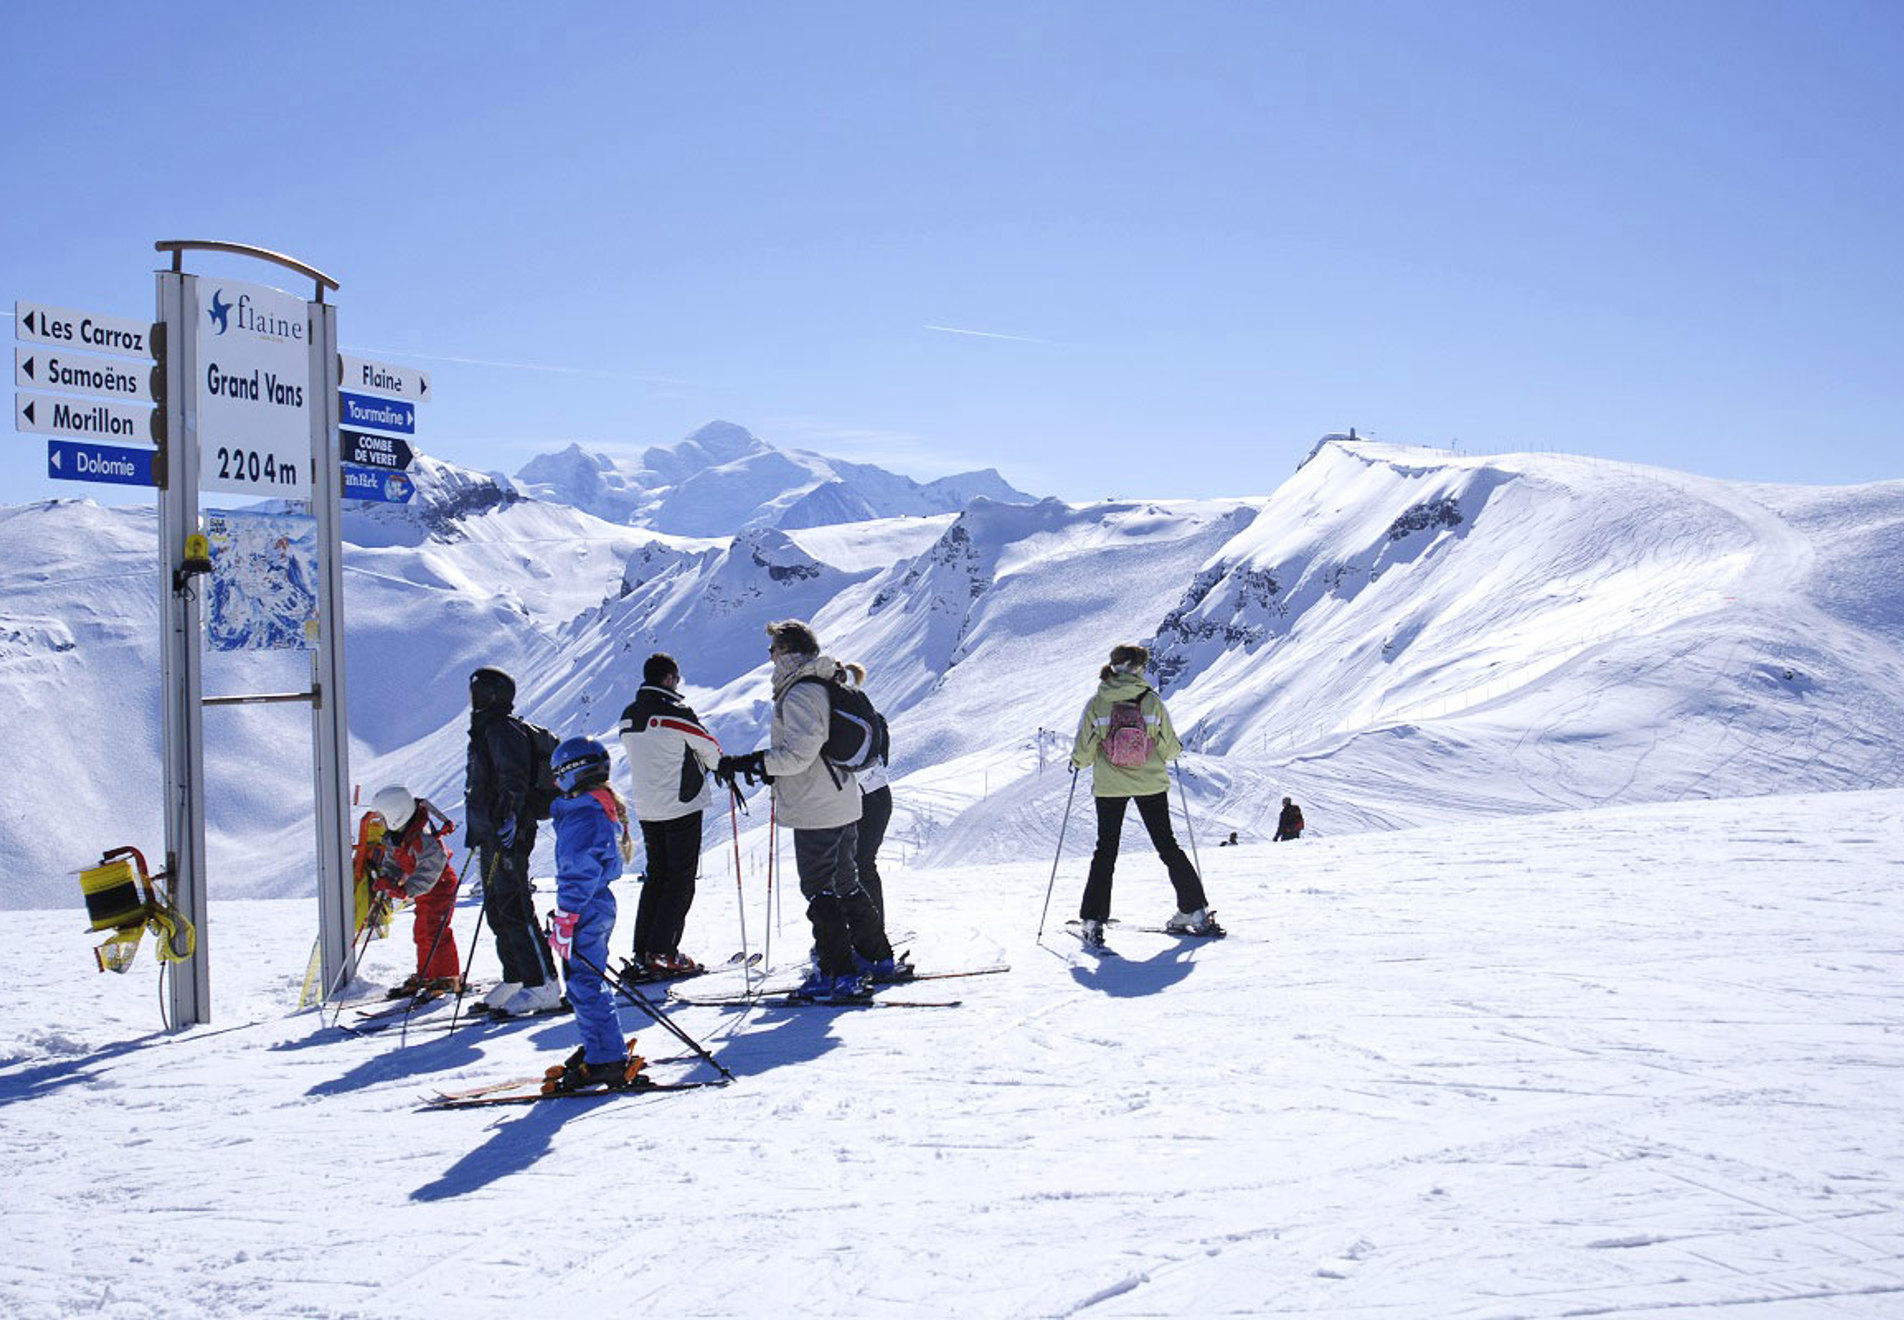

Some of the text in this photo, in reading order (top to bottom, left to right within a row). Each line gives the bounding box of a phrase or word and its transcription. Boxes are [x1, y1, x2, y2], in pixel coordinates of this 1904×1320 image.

[41, 311, 143, 351] Les Carroz
[236, 294, 303, 339] flaine
[48, 358, 137, 393] Samoëns
[207, 362, 303, 408] Grand Vans
[362, 364, 403, 392] Flaine
[53, 403, 134, 436] Morillon
[347, 400, 404, 425] Tourmaline
[354, 448, 398, 467] DE VERET
[358, 435, 393, 453] COMBE
[77, 451, 135, 477] Dolomie
